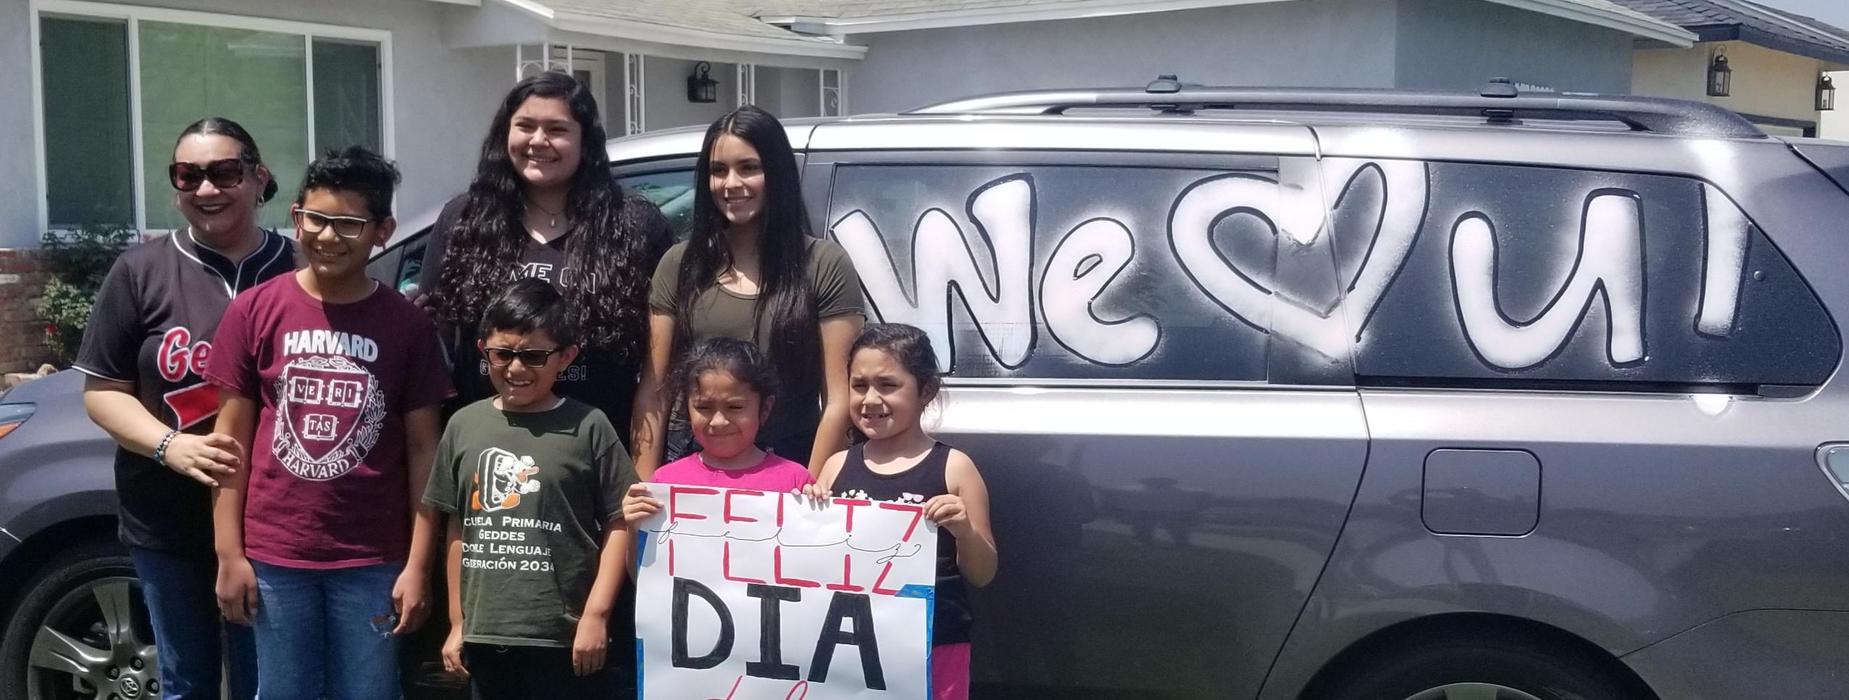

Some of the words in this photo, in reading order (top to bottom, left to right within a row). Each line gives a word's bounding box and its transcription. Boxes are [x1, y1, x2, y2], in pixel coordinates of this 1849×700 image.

[829, 172, 1162, 376] We
[157, 326, 213, 382] Ge
[284, 329, 379, 363] HARVARD
[309, 419, 332, 432] TAS
[281, 450, 351, 479] HARVARD
[478, 529, 526, 541] GEDDES
[502, 516, 562, 532] PRIMARIA
[671, 576, 887, 690] DIA
